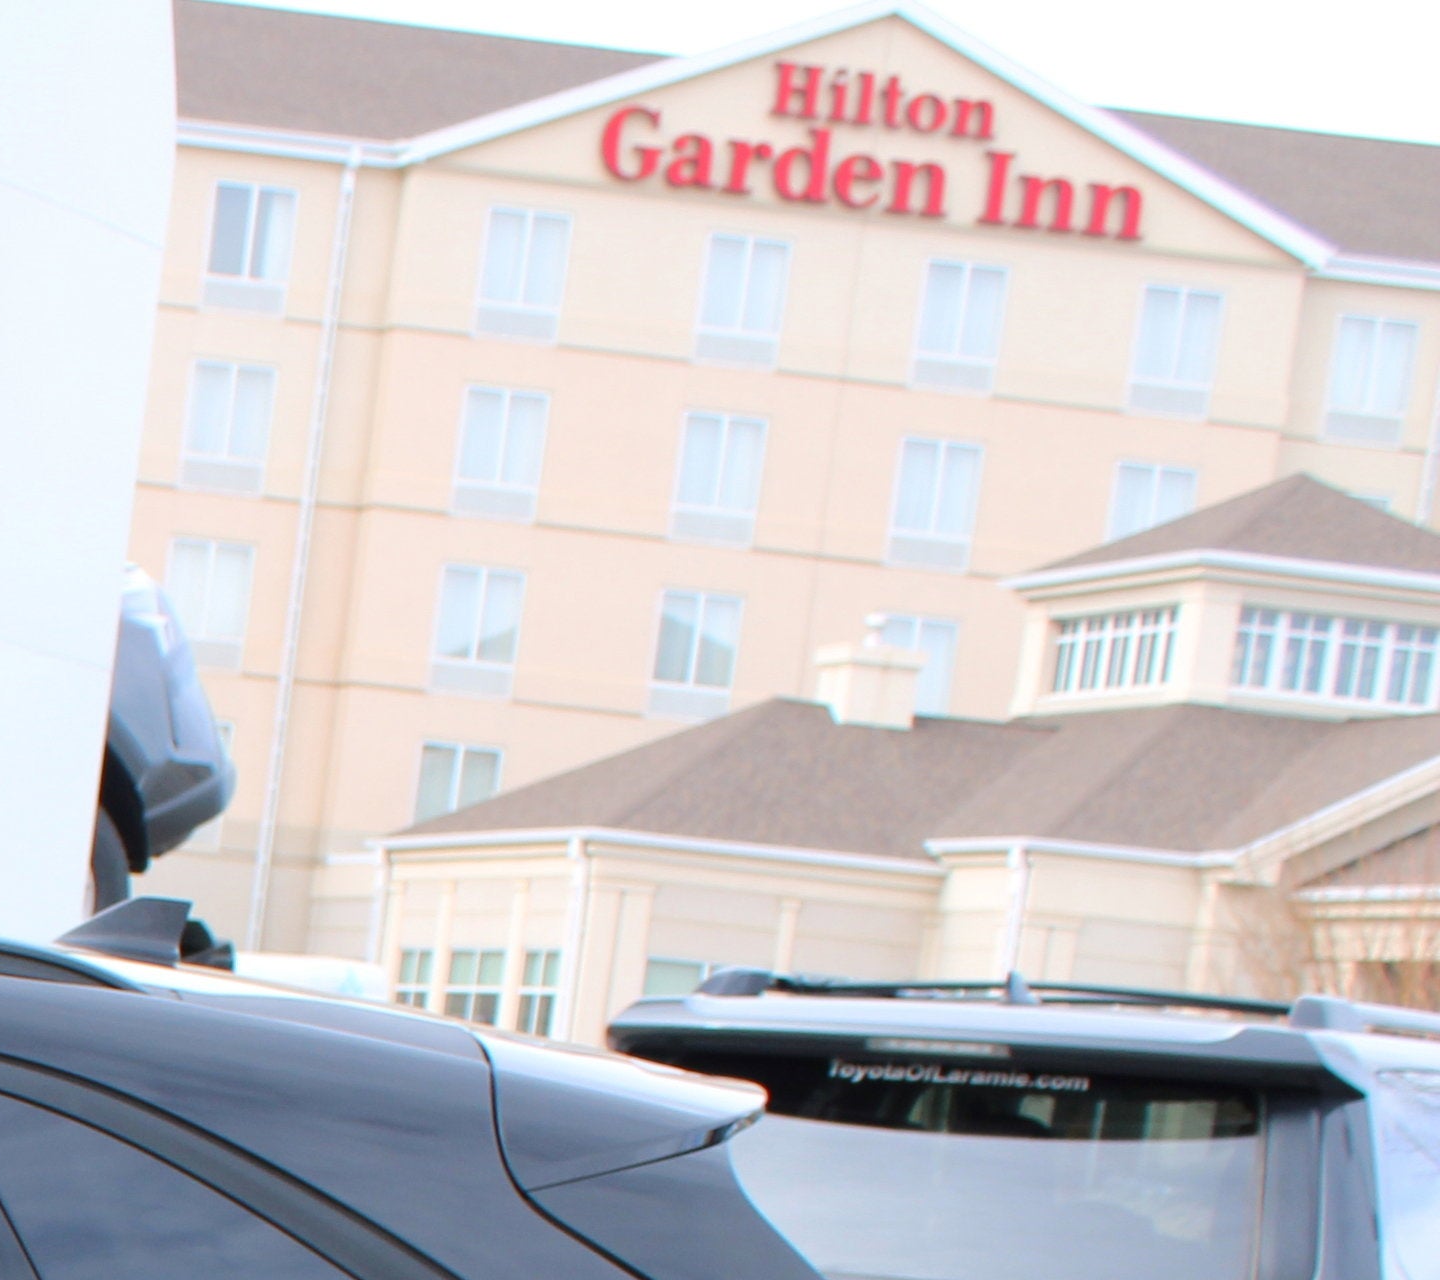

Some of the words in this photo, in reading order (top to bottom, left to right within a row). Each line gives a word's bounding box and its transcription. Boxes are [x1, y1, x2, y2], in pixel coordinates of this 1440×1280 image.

[770, 60, 995, 142] Hilton
[600, 106, 948, 218] Garden
[976, 149, 1142, 241] Inn
[828, 1057, 1091, 1092] ToyotaOfLaramie.com
